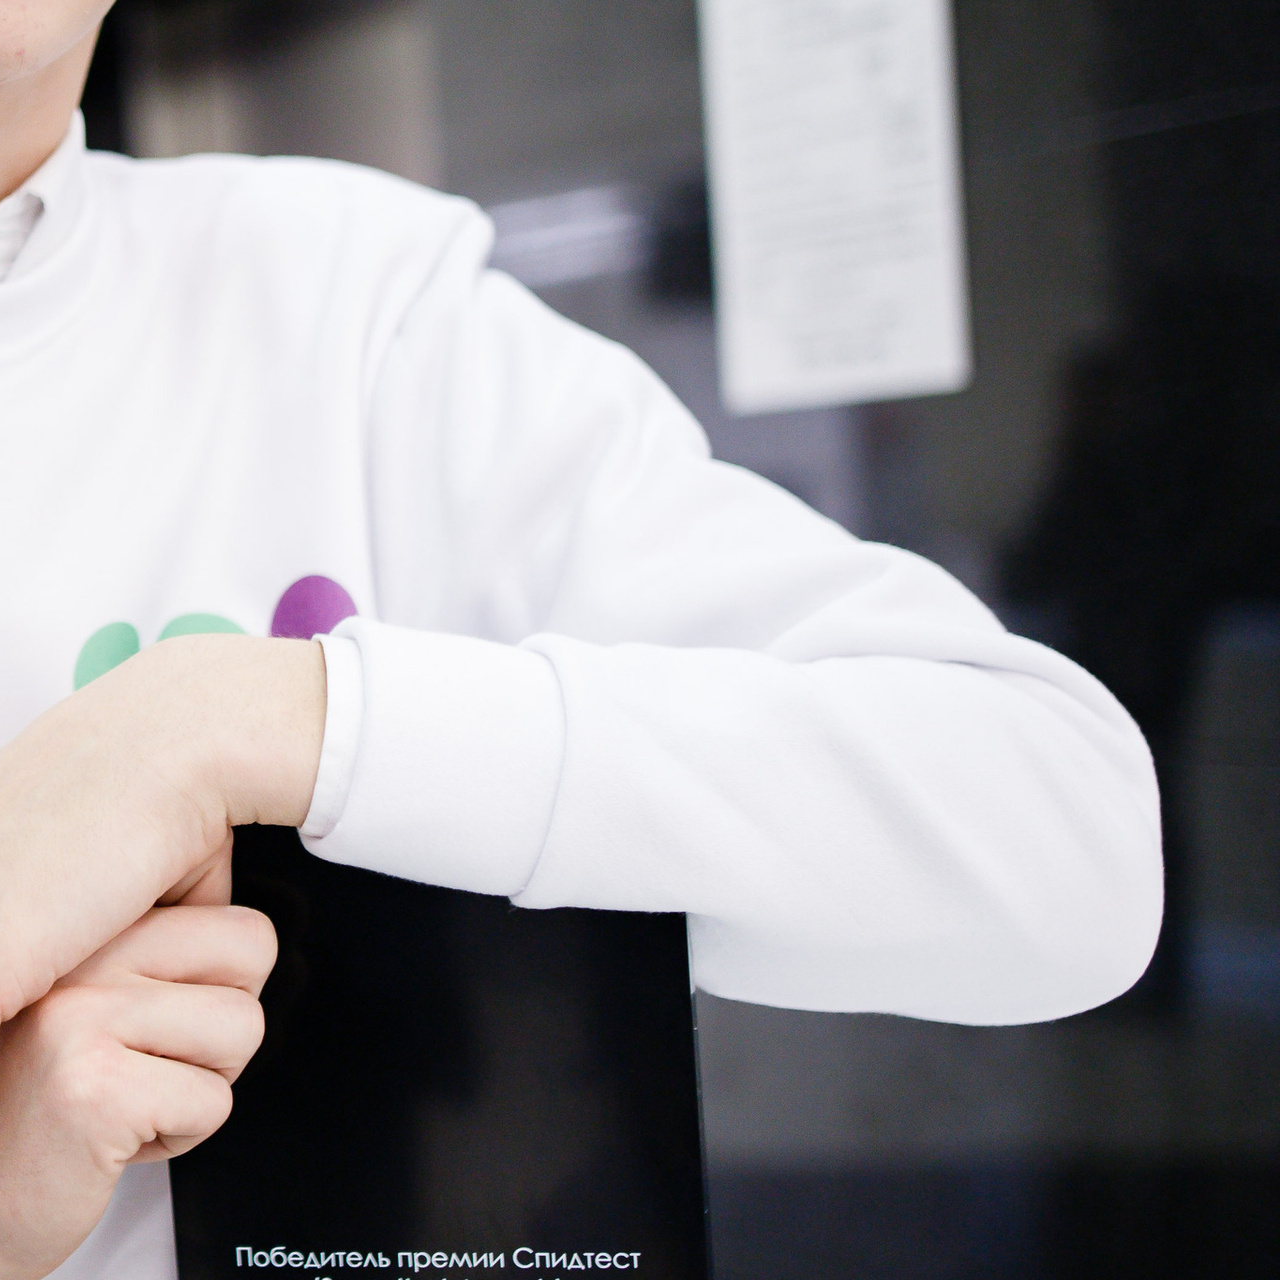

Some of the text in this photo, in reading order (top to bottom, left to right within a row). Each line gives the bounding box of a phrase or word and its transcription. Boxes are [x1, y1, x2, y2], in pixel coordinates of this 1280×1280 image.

[235, 1246, 642, 1273] Победитель премии Спидтест
